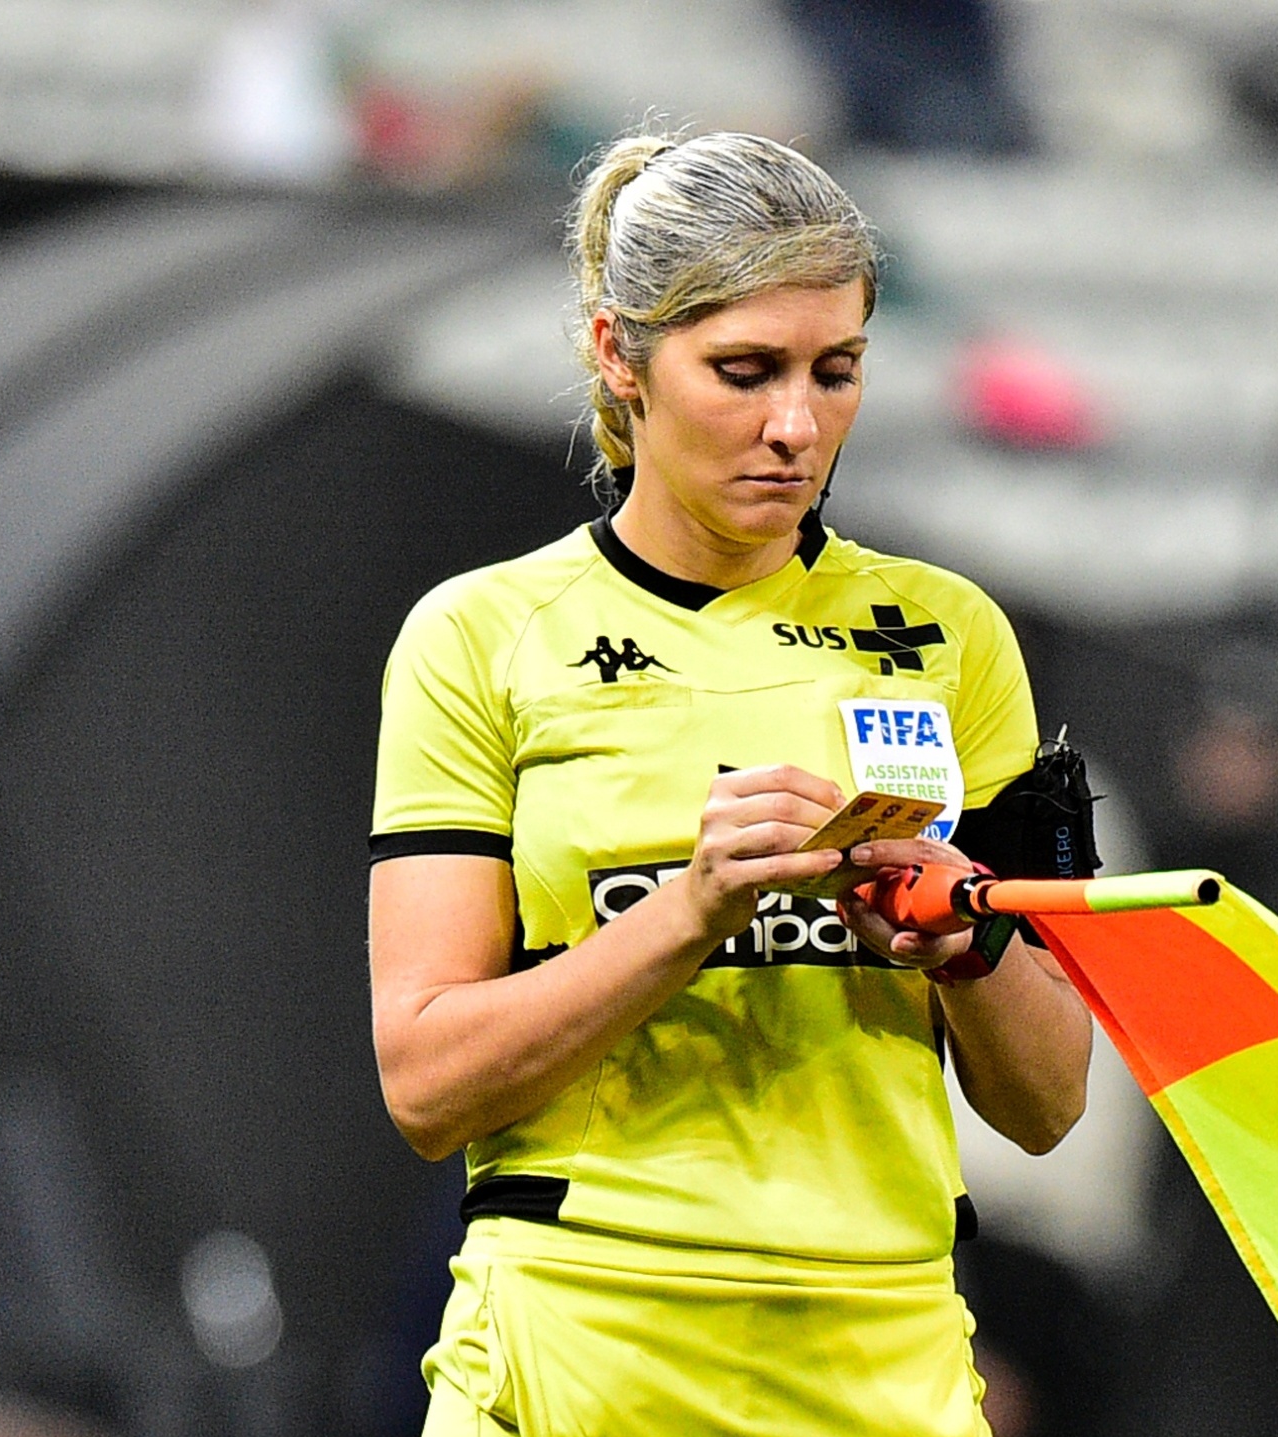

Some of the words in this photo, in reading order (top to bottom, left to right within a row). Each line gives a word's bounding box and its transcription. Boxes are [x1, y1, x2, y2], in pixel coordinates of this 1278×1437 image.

[772, 622, 848, 651] SUS
[852, 708, 944, 748] FIFA
[865, 764, 949, 782] ASSISTANT
